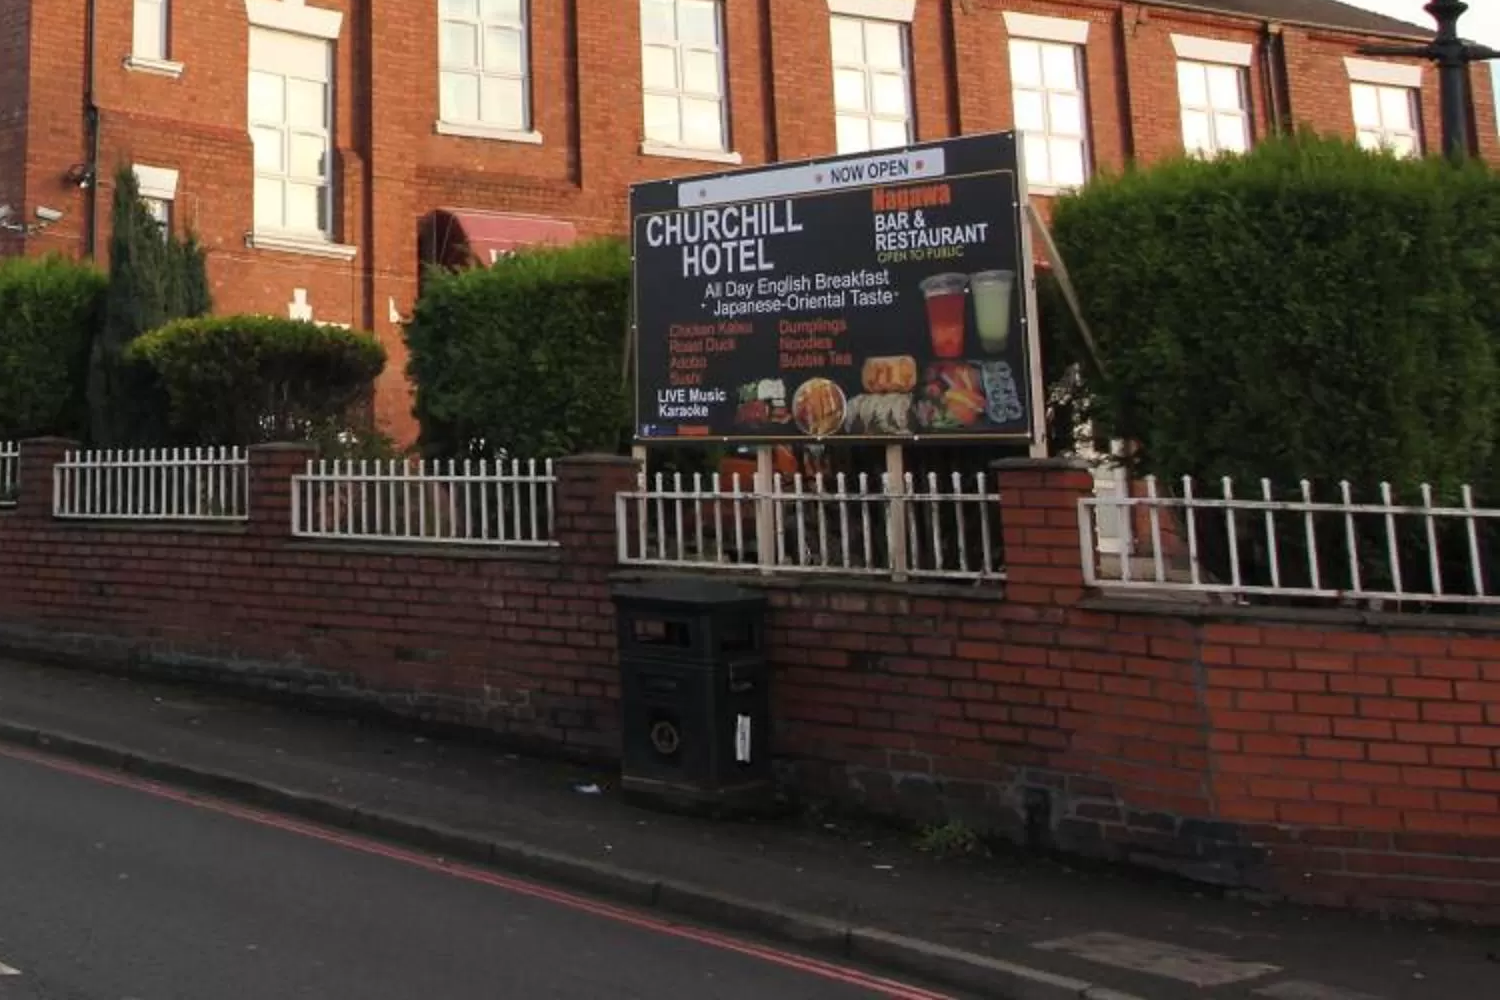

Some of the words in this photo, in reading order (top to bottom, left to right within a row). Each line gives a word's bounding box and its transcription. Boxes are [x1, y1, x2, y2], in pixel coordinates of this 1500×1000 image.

[830, 165, 864, 184] NOW
[867, 158, 909, 179] OPEN
[646, 199, 804, 247] CHURCHILL
[875, 211, 909, 233] BAR
[913, 209, 925, 228] &
[875, 222, 989, 251] RESTAURANT
[682, 237, 775, 279] HOTEL
[704, 282, 723, 299] All
[725, 280, 754, 299] Day
[757, 274, 811, 297] English
[815, 268, 890, 291] Breakfast
[713, 290, 846, 319] Japanese-Oriental
[850, 289, 894, 307] Taste
[779, 318, 848, 336] Dumplings
[657, 388, 685, 403] LIVE
[688, 387, 727, 402] Music
[659, 402, 709, 418] Karaoke
